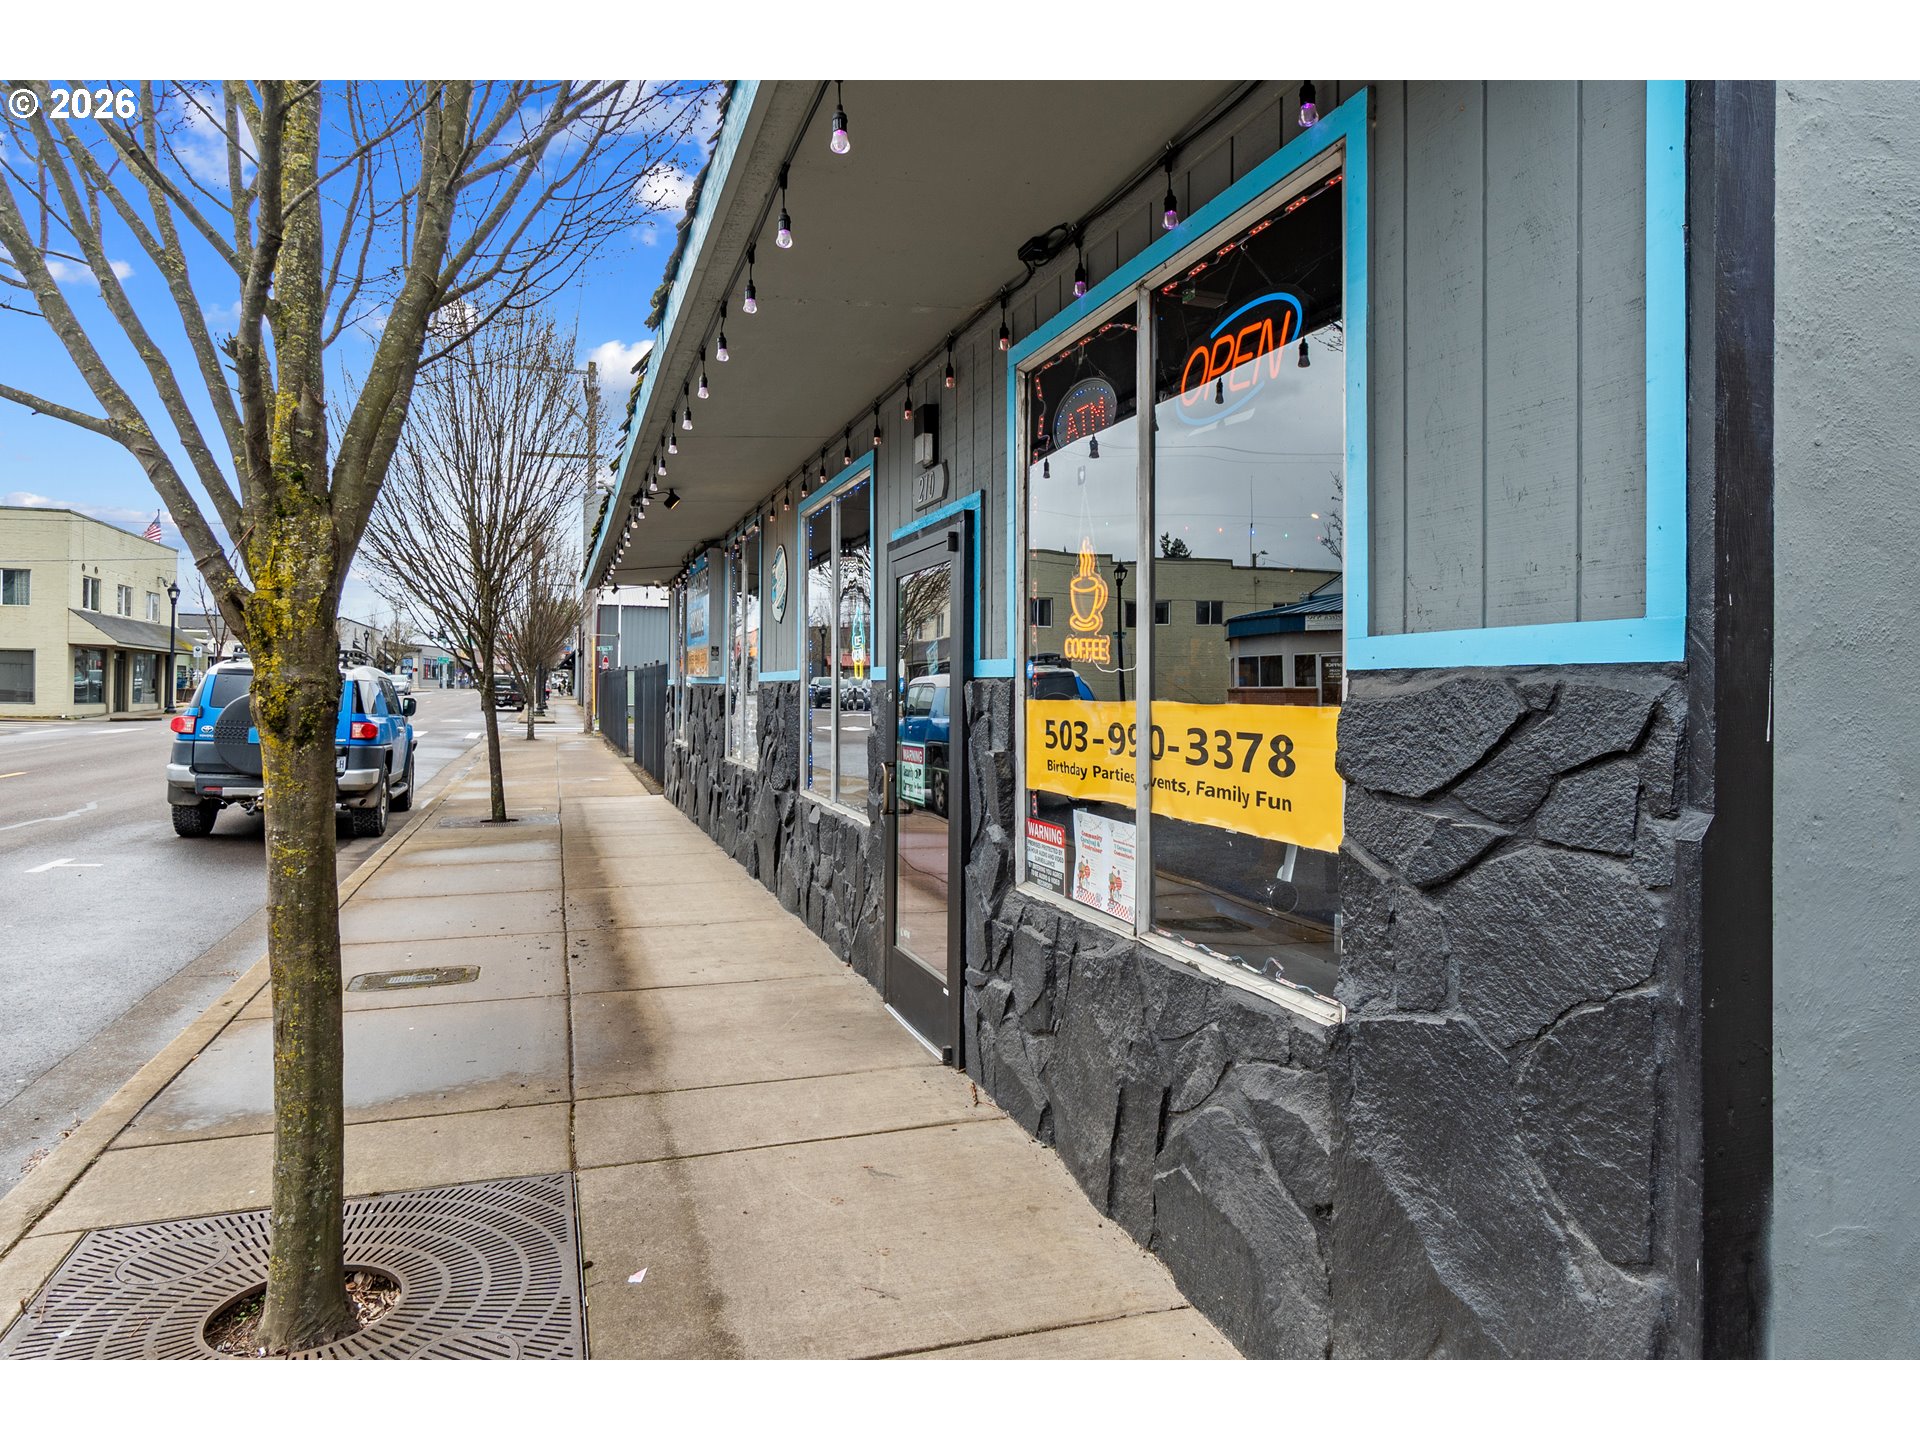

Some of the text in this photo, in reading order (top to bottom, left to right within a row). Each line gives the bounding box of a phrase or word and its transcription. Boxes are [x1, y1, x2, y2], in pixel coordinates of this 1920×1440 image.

[1181, 310, 1291, 406] OPEN
[1066, 395, 1105, 443] ATM
[918, 471, 935, 503] 210
[1064, 638, 1107, 661] COFFEE
[1047, 760, 1088, 780] Birthday
[1151, 777, 1190, 796] vents,
[1196, 780, 1250, 809] Family
[1256, 790, 1292, 812] Fun
[1027, 821, 1063, 845] WARNING
